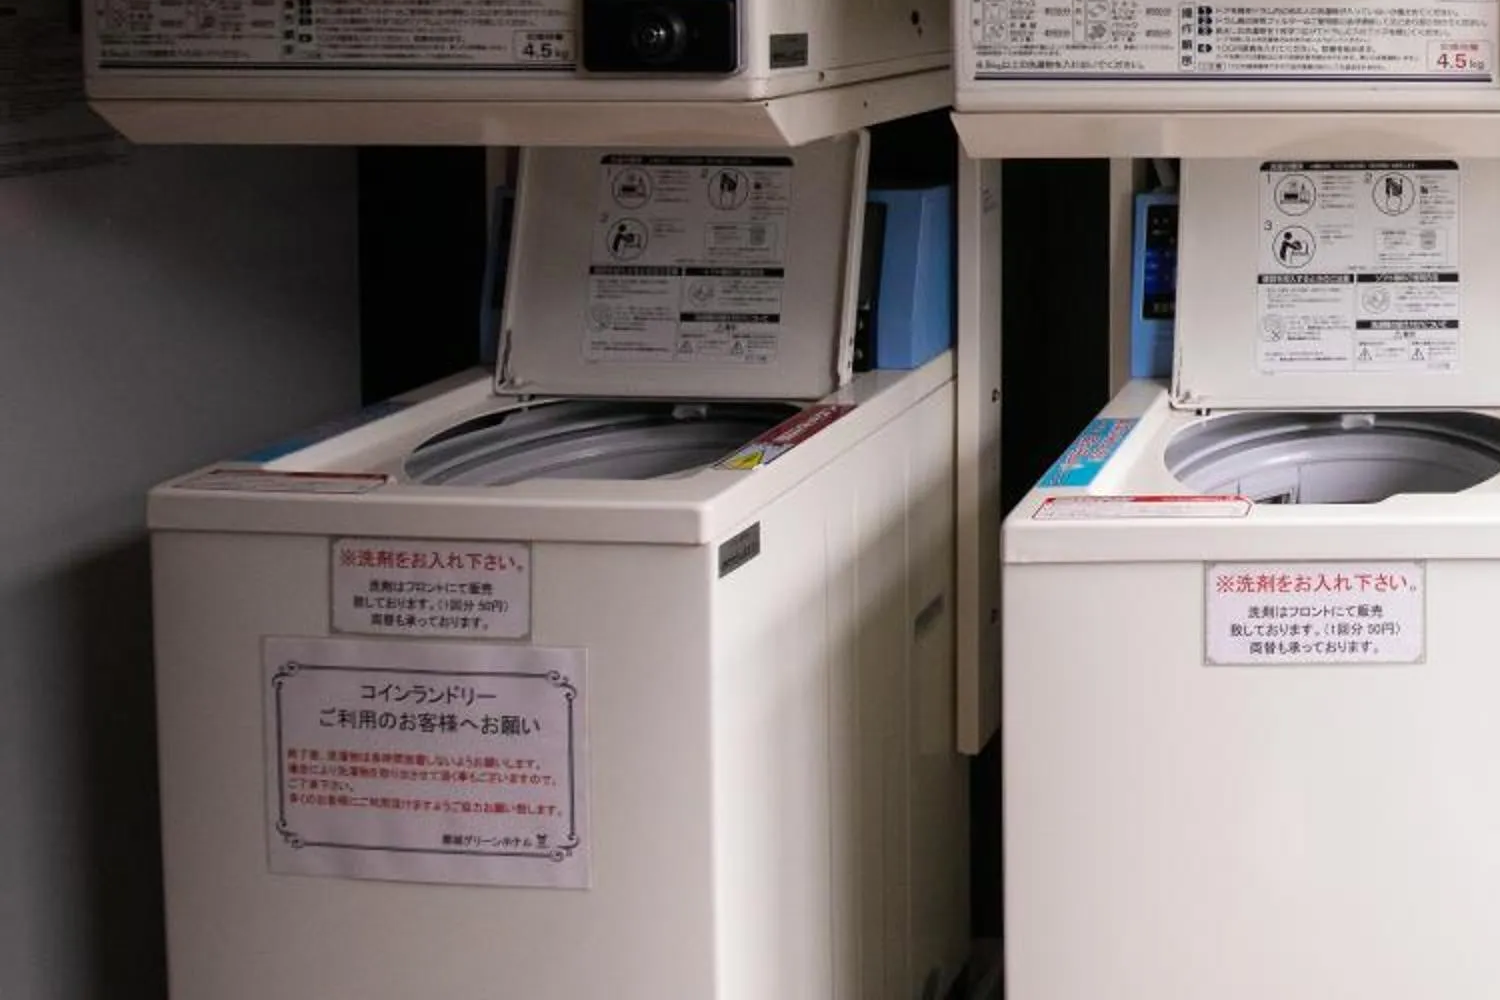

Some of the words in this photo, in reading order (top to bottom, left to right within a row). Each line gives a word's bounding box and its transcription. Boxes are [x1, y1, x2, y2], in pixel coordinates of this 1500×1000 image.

[339, 548, 524, 571] ※洗剤をお入れ下さい。
[1216, 573, 1417, 593] ※洗剤をお入れ下さい。
[1247, 604, 1384, 619] 洗剤はフロントにて販売
[1249, 640, 1380, 655] 両替も承っております。
[361, 684, 497, 706] コインランドリー
[318, 706, 541, 737] ご利用のお客様へお願い
